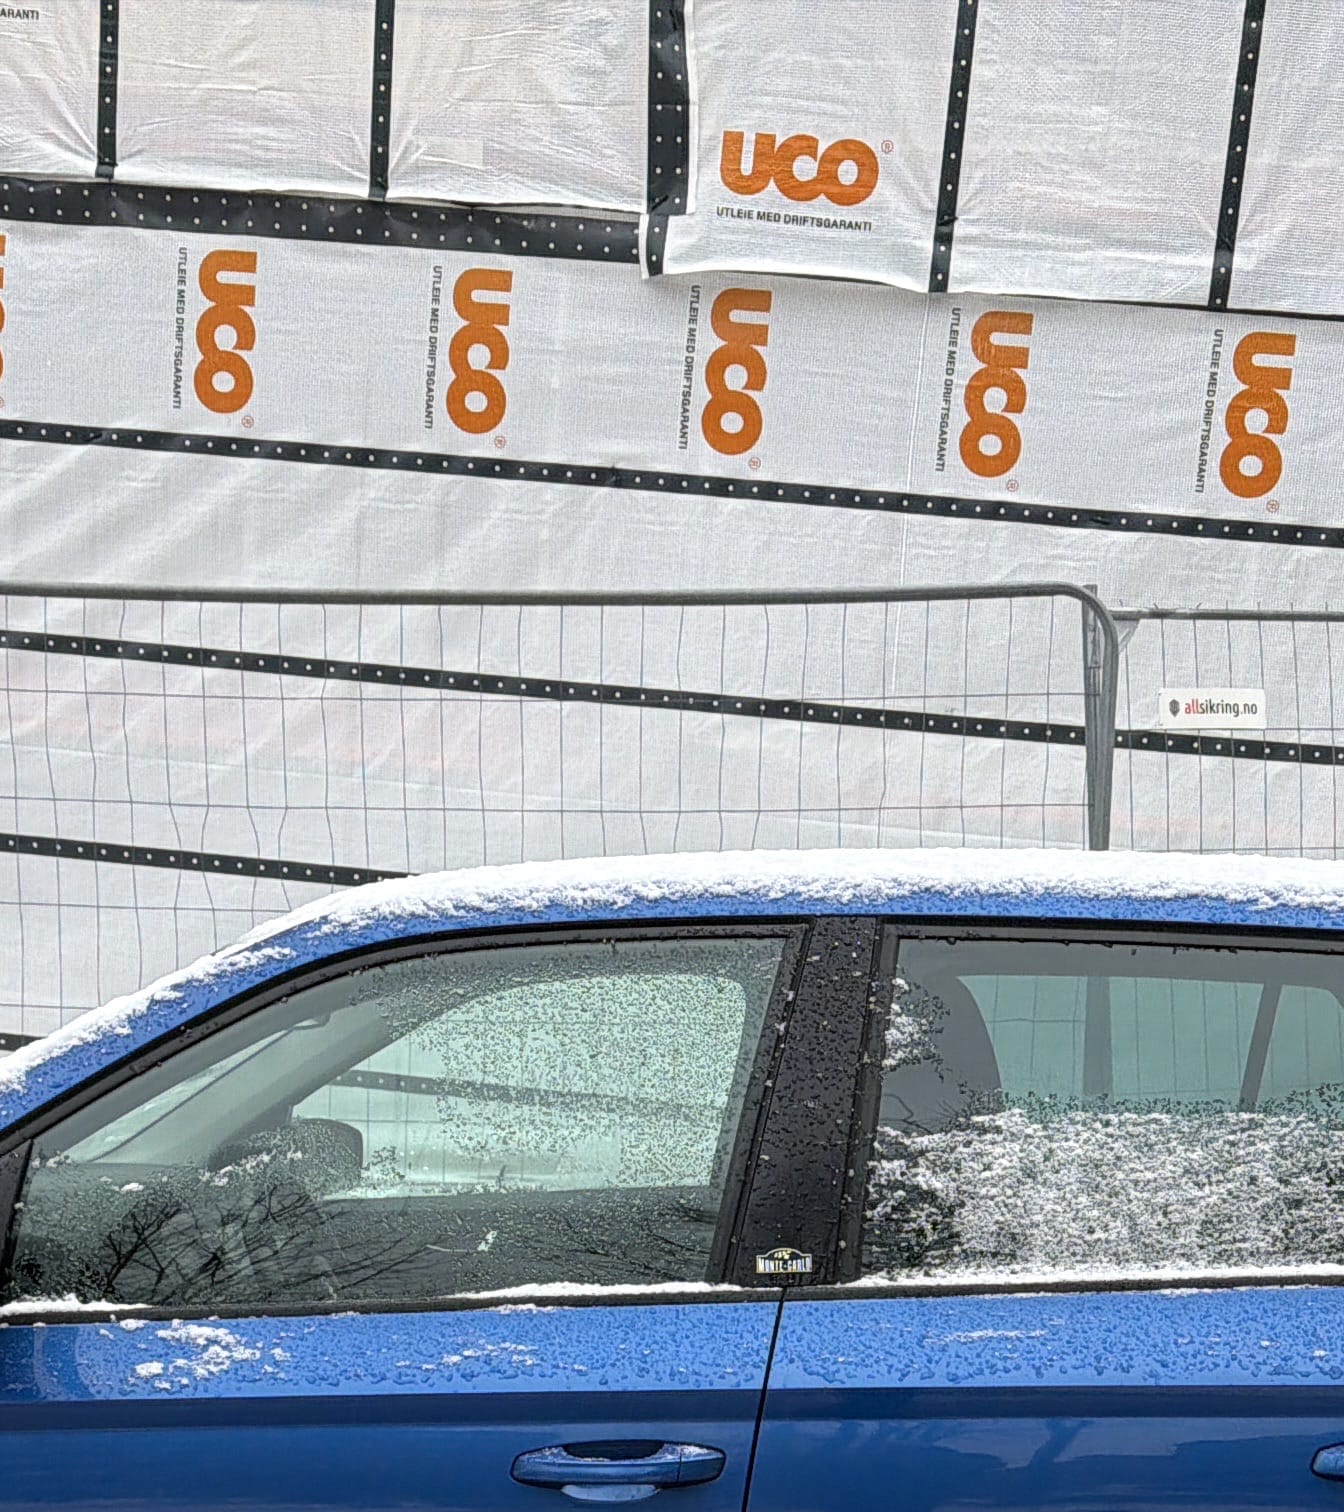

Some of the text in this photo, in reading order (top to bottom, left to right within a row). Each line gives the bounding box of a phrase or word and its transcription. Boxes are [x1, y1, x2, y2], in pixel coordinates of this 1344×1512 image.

[716, 205, 875, 232] UTLEIE MED DRIFTSGARANTI
[719, 130, 879, 206] UCO
[172, 246, 188, 410] UTLEIE MED DRIFTSGARANTI
[193, 249, 258, 415] UCO
[424, 265, 443, 430] UTLEIE MED DRIFTSGARANTI
[444, 267, 514, 435] UCO
[678, 284, 701, 450] UTLEIE MED DRIFTSGARANTI
[700, 287, 773, 456] UCO
[935, 307, 961, 473] UTLEIE MED DRIFTSGARANTI
[958, 310, 1034, 479] UCO
[1195, 328, 1224, 494] UTLEIE MED DRIFTSGARANTI
[1218, 331, 1297, 499] UCO
[1184, 698, 1258, 718] allsikring.no
